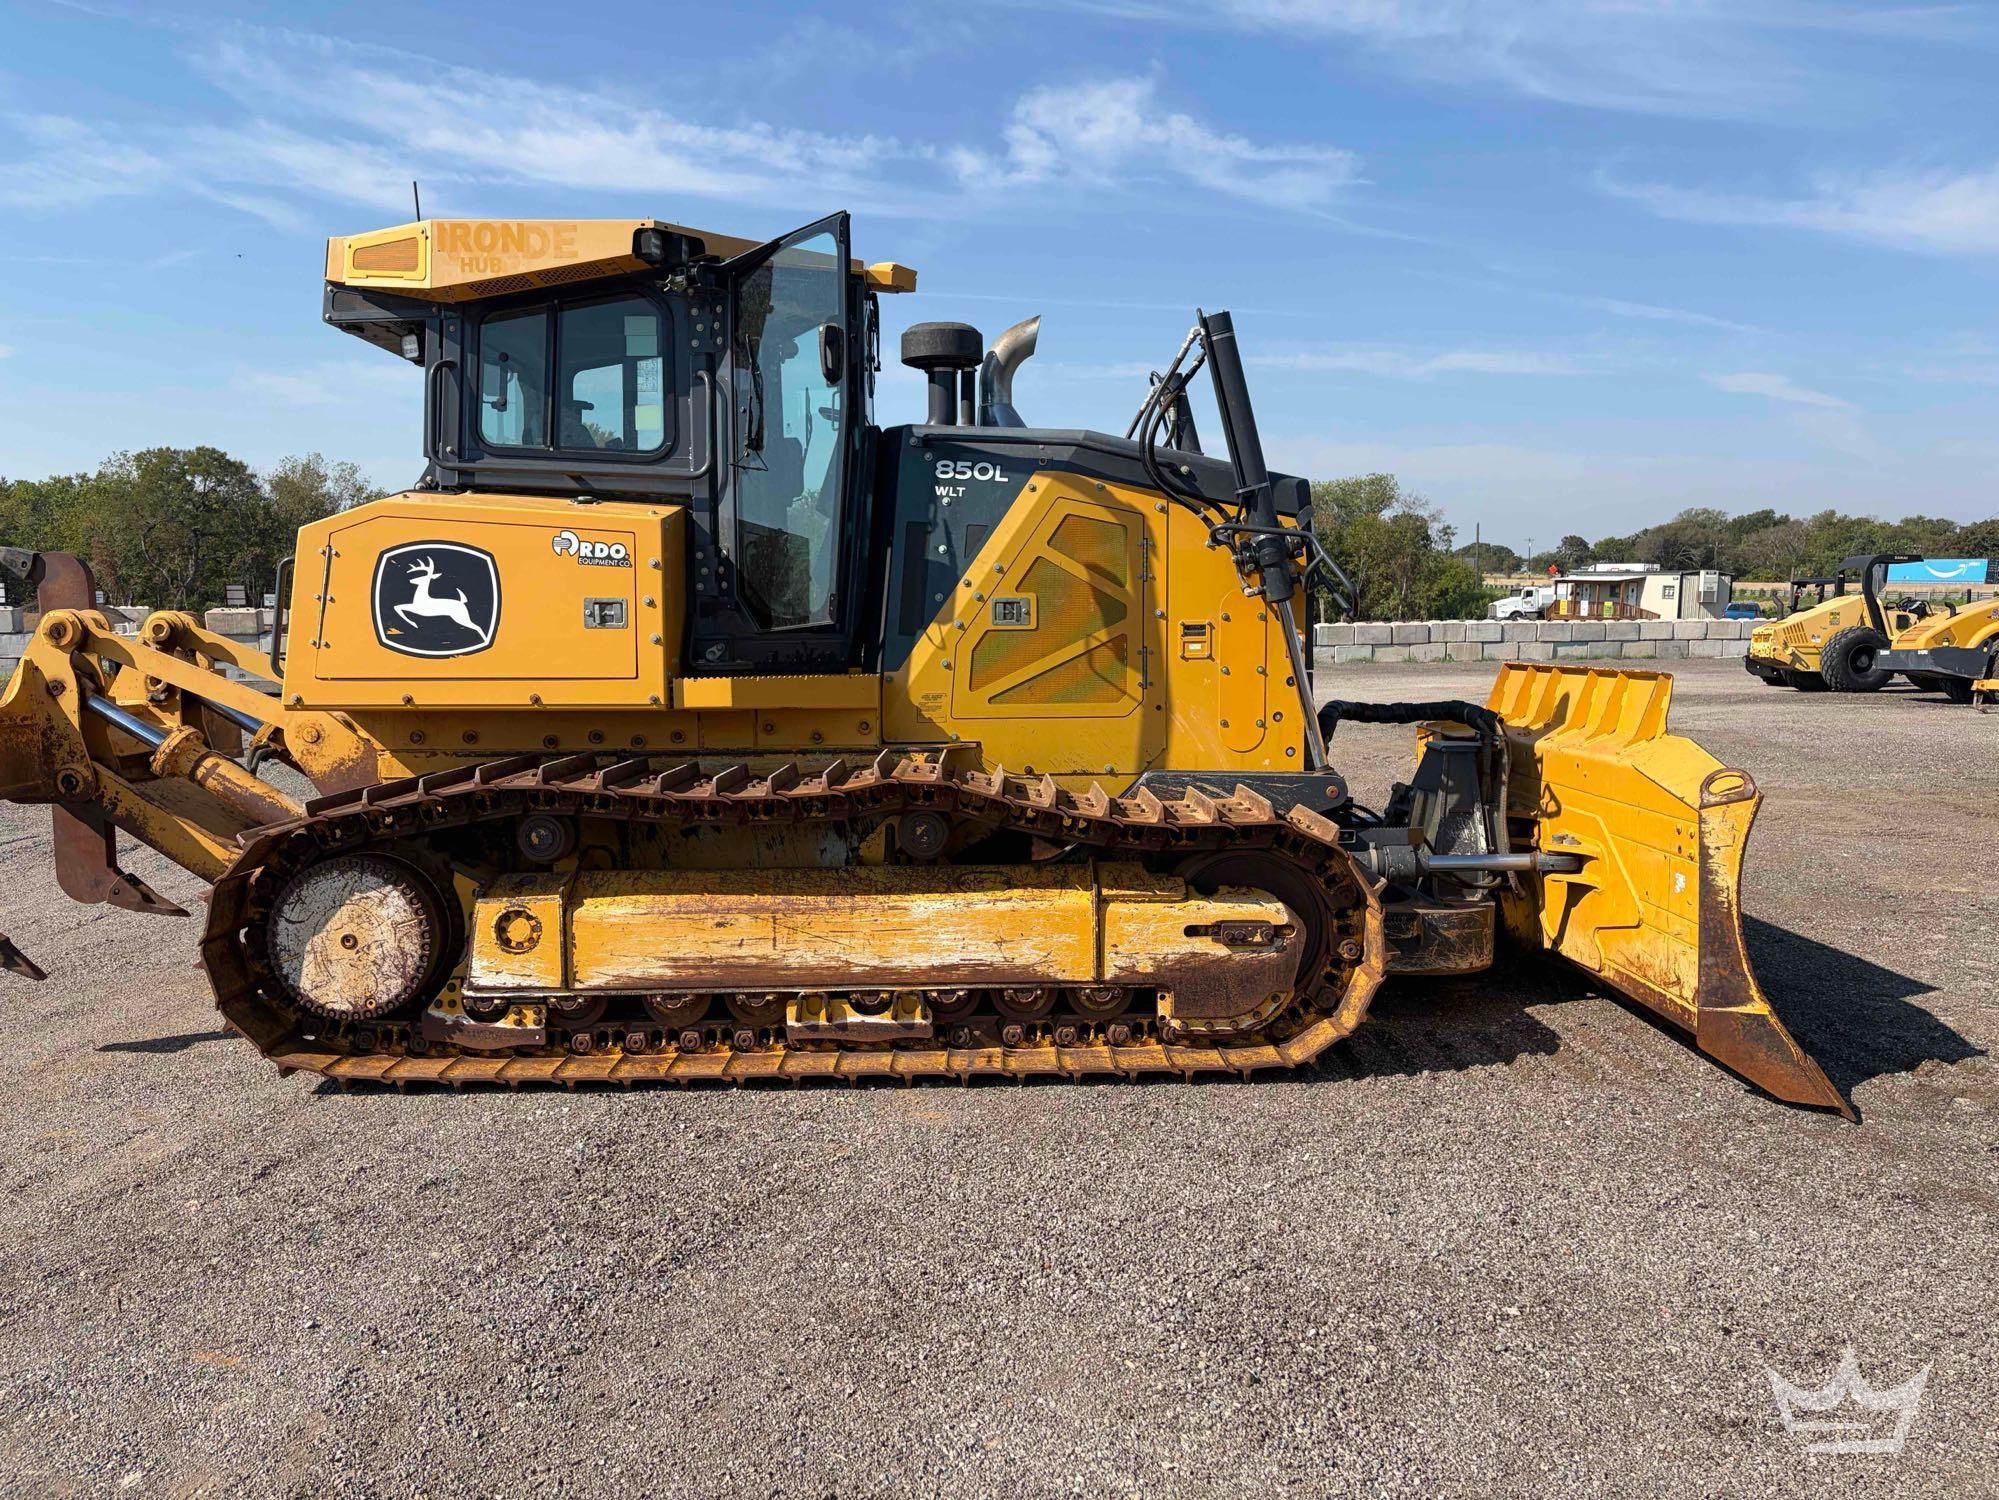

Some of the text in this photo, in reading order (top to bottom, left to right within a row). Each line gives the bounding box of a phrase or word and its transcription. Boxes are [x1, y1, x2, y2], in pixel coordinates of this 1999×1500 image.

[437, 222, 525, 253] IRON
[460, 256, 502, 274] HUB
[935, 459, 1009, 482] 850L
[935, 485, 966, 497] WLT
[579, 557, 618, 567] EQUIPMENT
